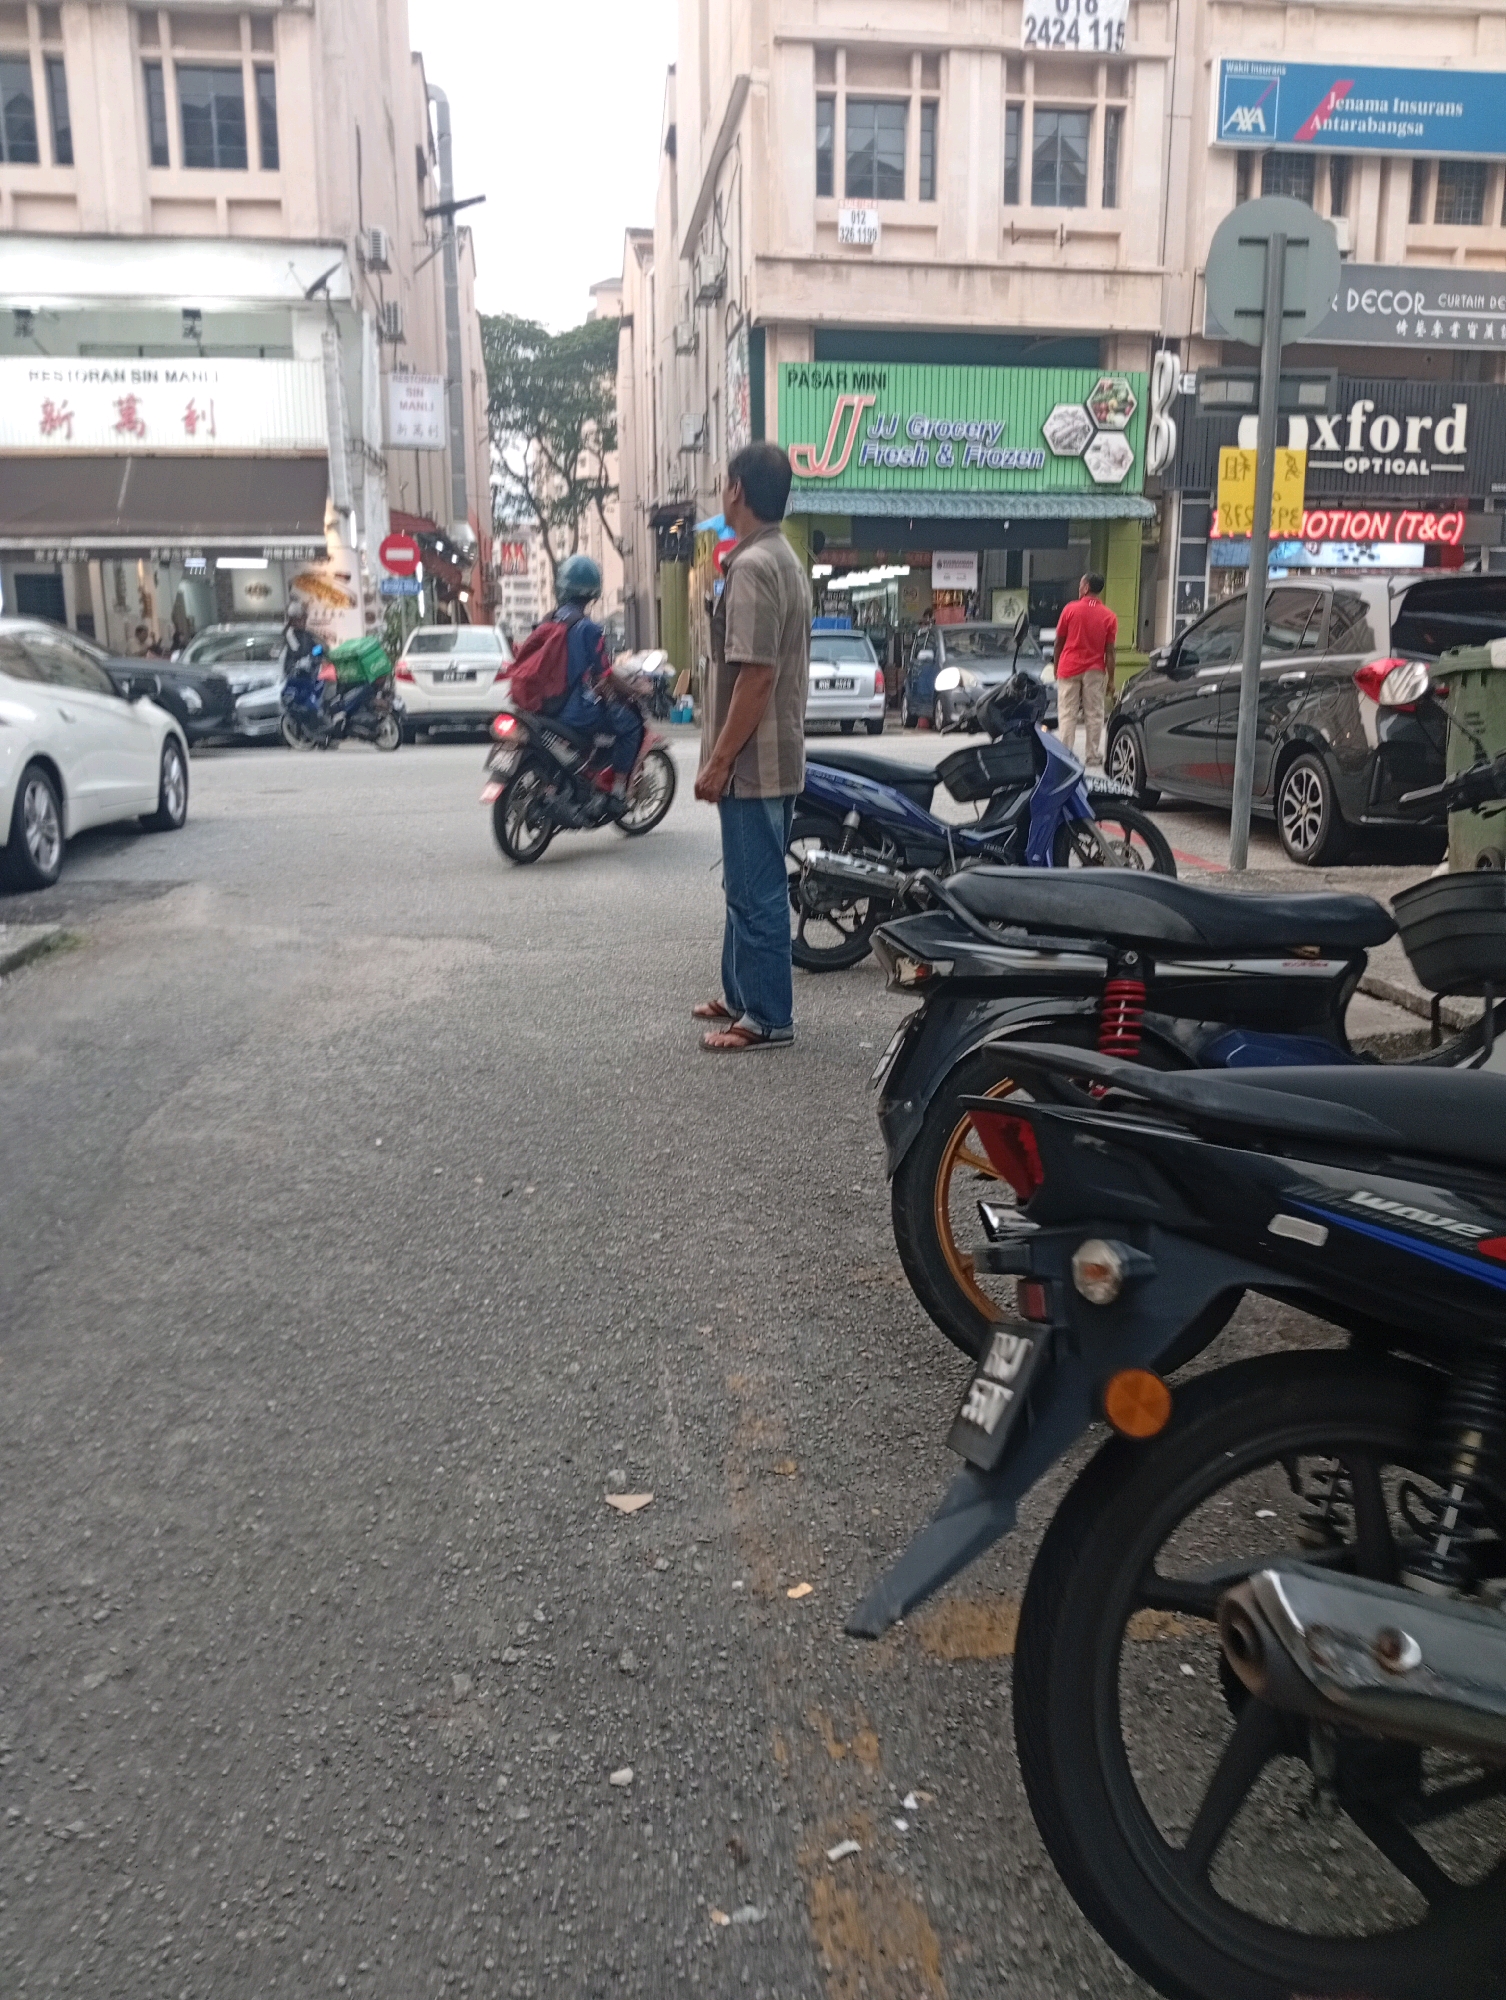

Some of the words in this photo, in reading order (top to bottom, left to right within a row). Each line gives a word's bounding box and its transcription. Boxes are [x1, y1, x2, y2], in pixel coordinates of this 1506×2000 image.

[1024, 14, 1080, 50] 2424
[1226, 60, 1249, 74] Wakil
[1251, 62, 1287, 76] Insurans
[1327, 91, 1388, 114] Jenama
[1393, 96, 1464, 118] Insurans
[1223, 104, 1266, 132] AXA
[1310, 114, 1424, 138] Antarabangsa
[1346, 287, 1425, 315] DECOR
[1438, 292, 1485, 309] CURTAIN
[28, 368, 126, 384] RESTORAN
[130, 368, 159, 384] SIN
[165, 369, 219, 384] MANLI
[391, 374, 439, 385] RESTORAN
[787, 368, 848, 390] PASAR
[852, 370, 887, 391] MINI
[406, 387, 424, 398] SIN
[399, 400, 434, 412] MANLI
[867, 411, 900, 441] JJ
[905, 411, 1006, 448] Grocery
[858, 439, 930, 468] Fresh
[935, 441, 955, 468] &
[961, 441, 1046, 469] Frozen
[1343, 457, 1430, 476] OPTICAL
[1394, 508, 1466, 545] (T&C)
